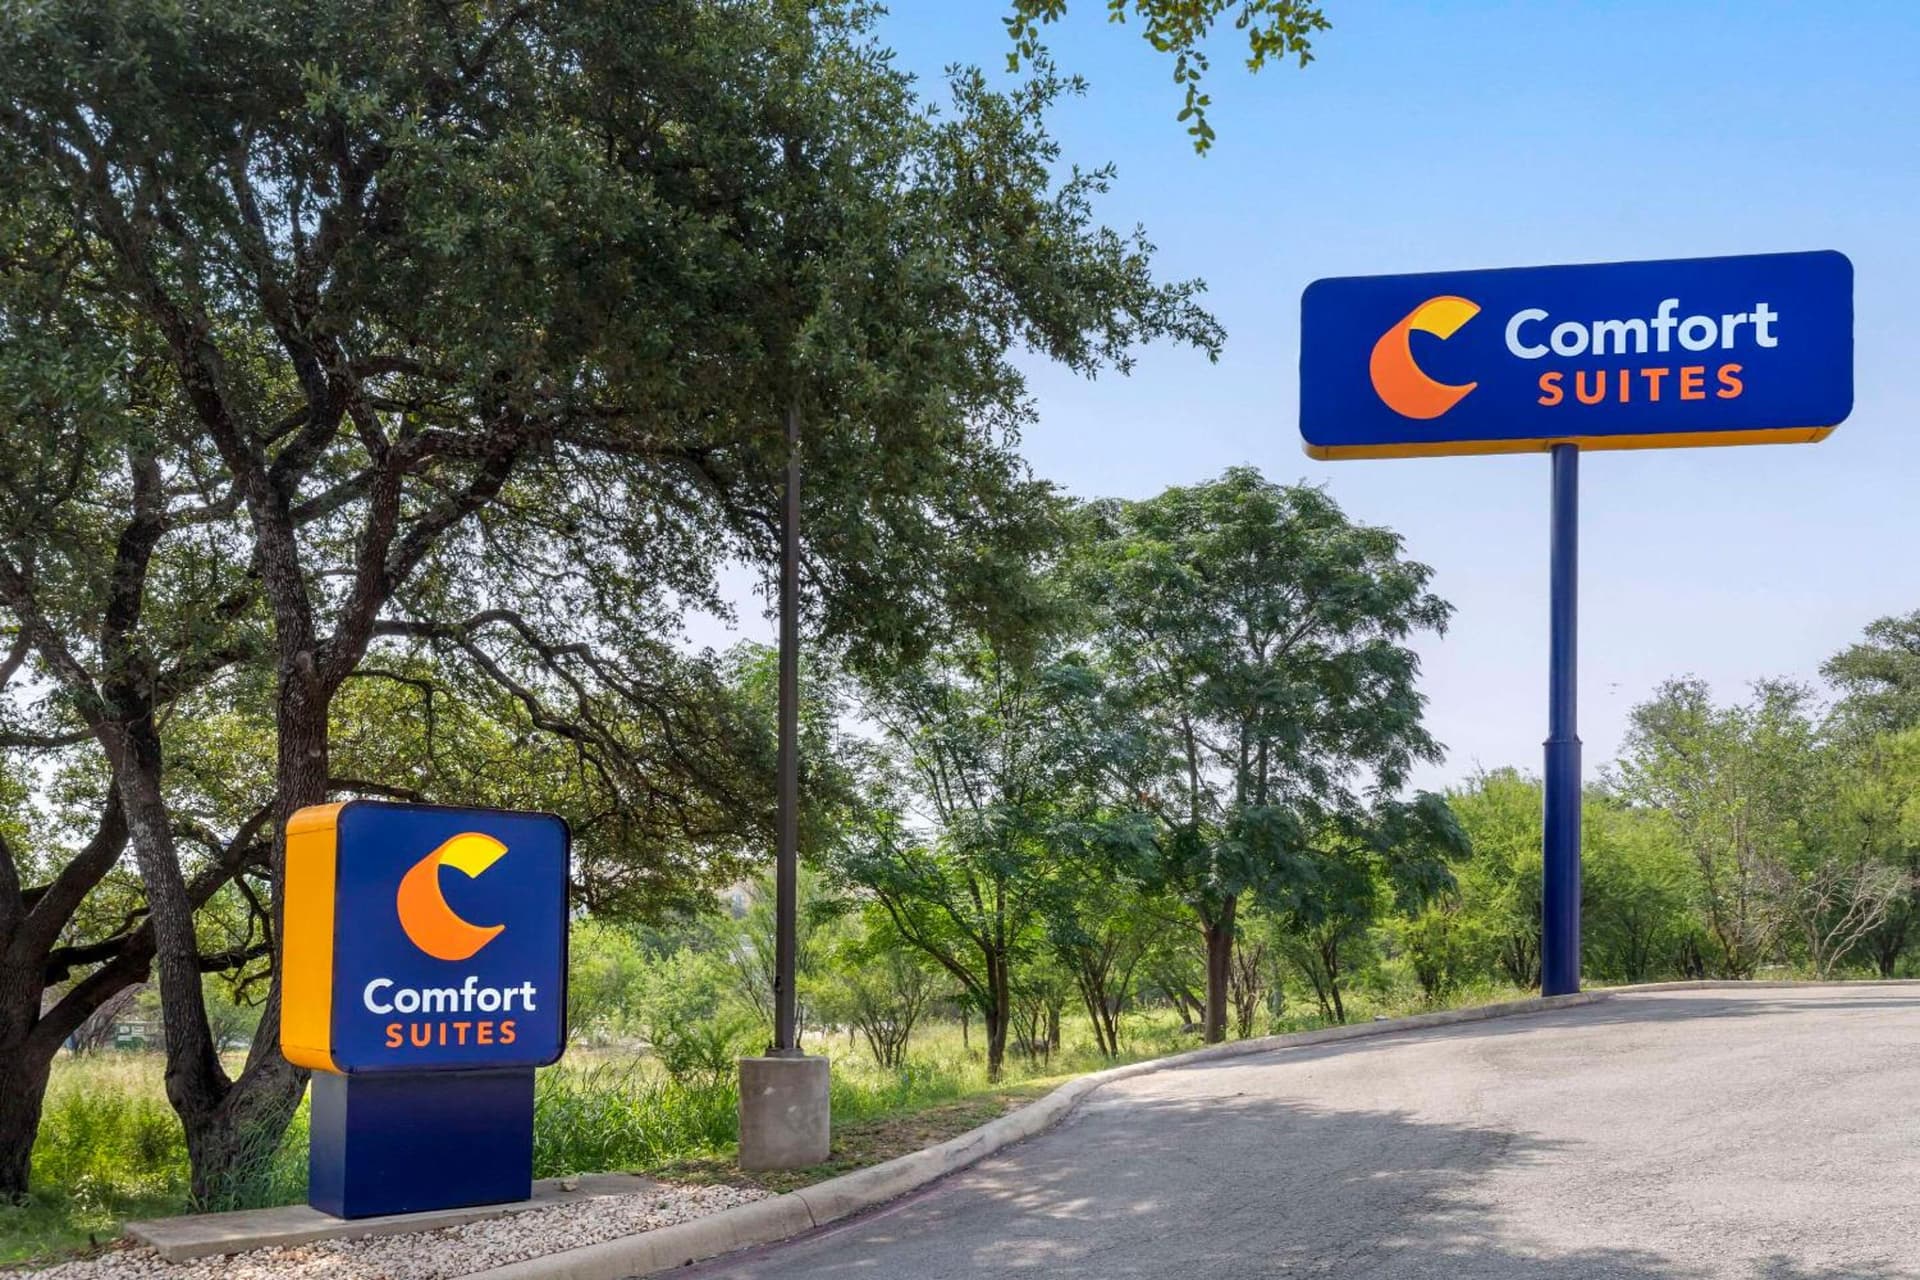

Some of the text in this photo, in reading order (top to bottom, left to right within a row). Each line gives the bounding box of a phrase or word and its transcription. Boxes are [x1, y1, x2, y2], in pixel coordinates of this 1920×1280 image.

[1505, 298, 1779, 359] Comfort
[1538, 363, 1743, 406] SUITES
[363, 975, 537, 1015] Comfort
[385, 1020, 517, 1048] SUITES
